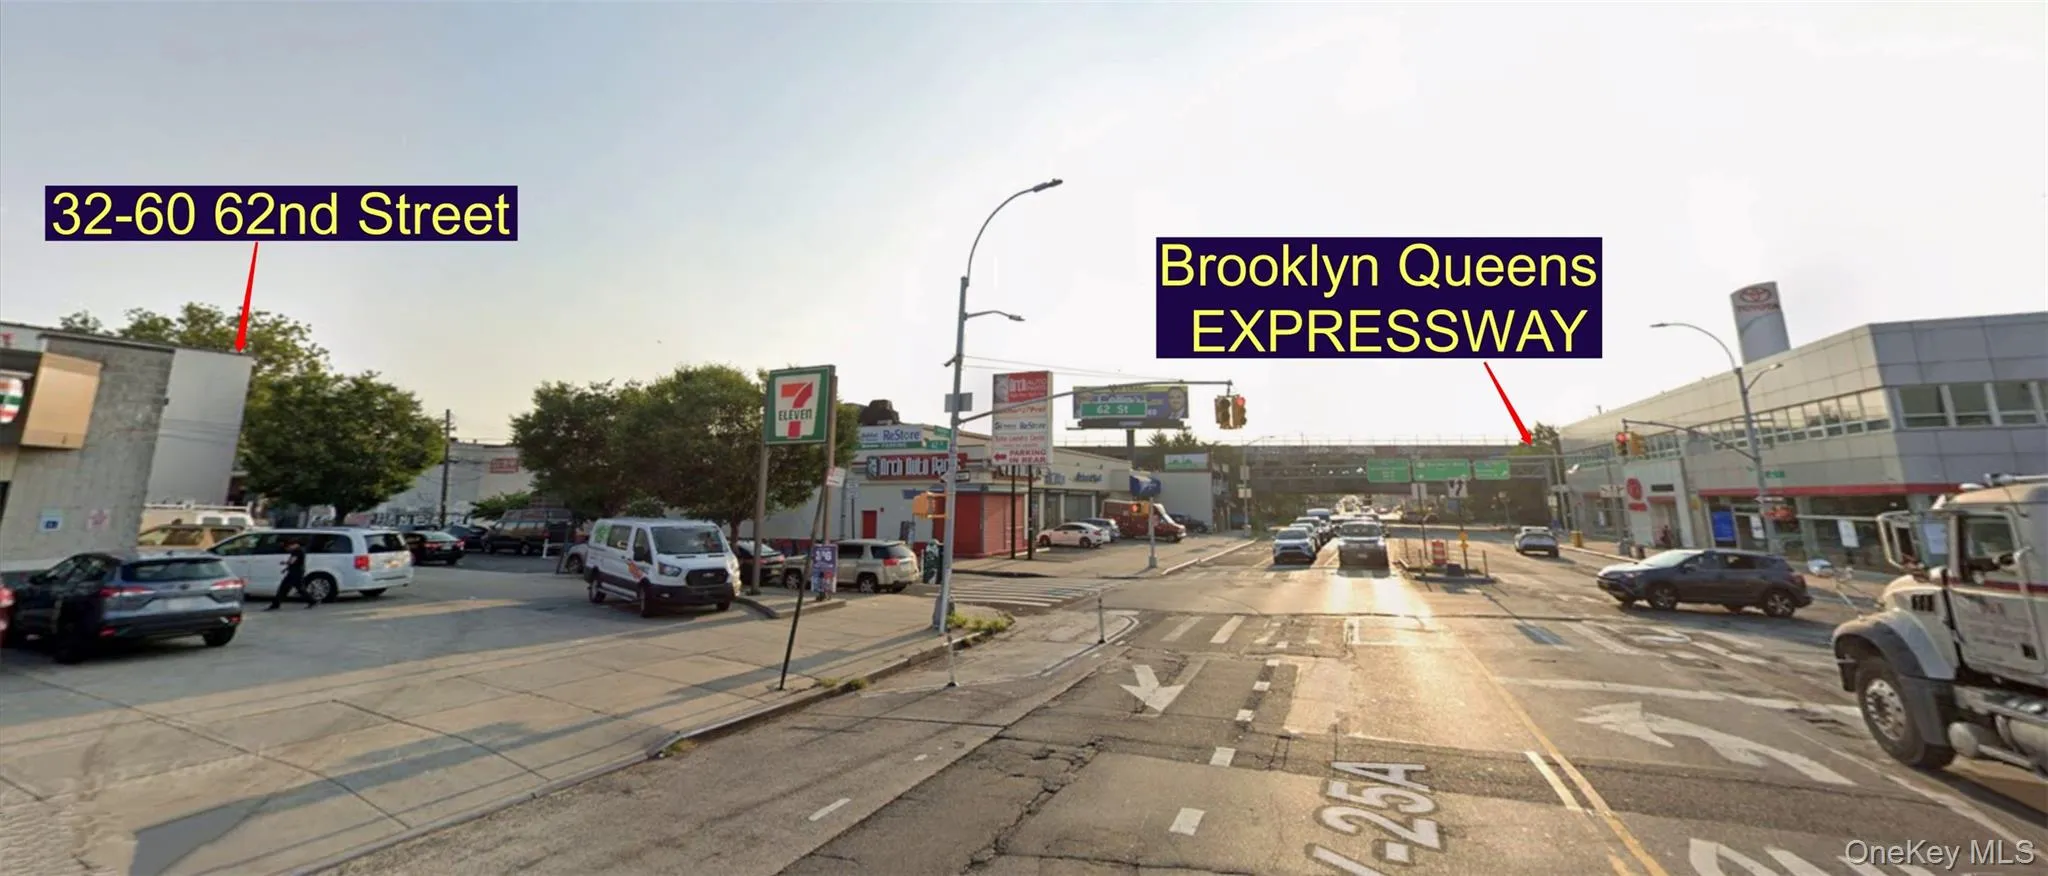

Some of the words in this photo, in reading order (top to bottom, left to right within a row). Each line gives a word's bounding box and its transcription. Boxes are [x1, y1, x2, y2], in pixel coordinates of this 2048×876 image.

[780, 381, 814, 439] 7
[1096, 405, 1111, 414] 62
[1117, 405, 1129, 414] St
[882, 428, 921, 440] ReStore
